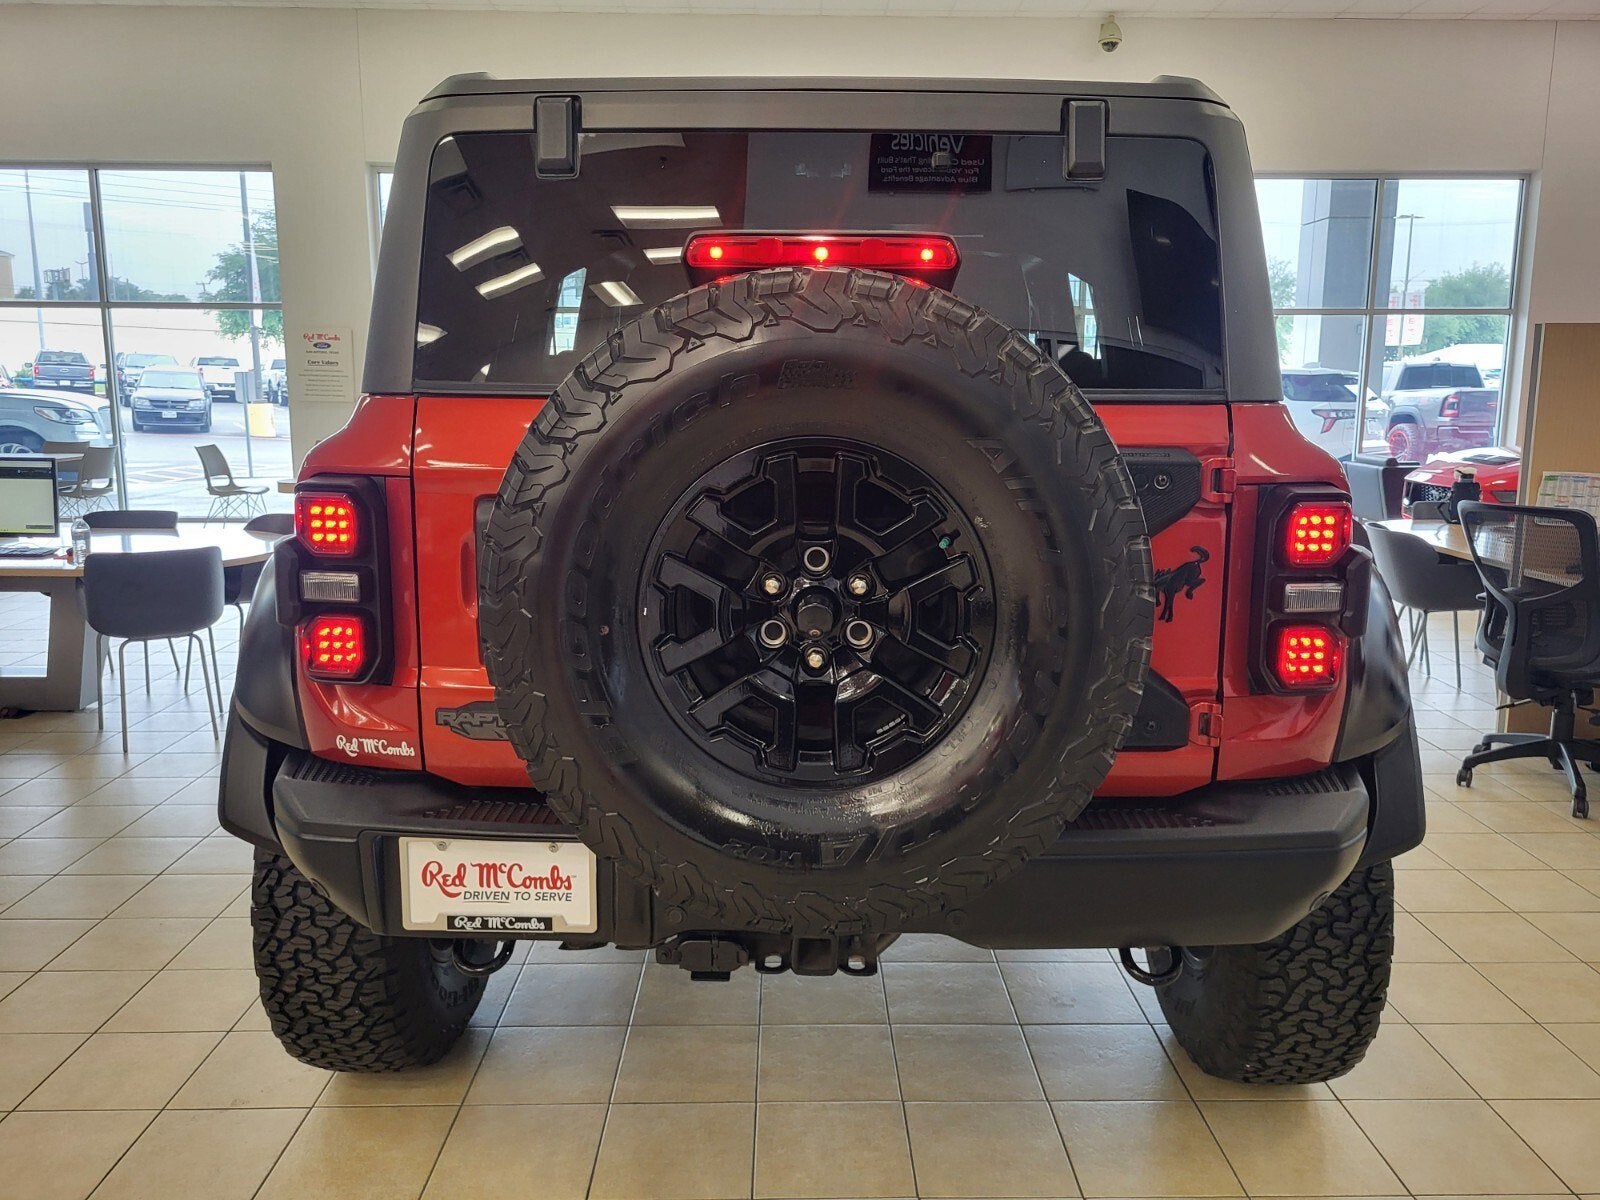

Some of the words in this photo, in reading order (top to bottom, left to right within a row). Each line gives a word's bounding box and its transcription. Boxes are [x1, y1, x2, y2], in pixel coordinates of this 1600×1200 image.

[336, 734, 359, 757] Red
[359, 737, 416, 757] McCombs
[421, 860, 468, 898] Red
[469, 862, 573, 891] McCombs
[463, 890, 510, 901] DRIVEN
[514, 891, 531, 901] TO
[534, 891, 573, 902] SERVE
[454, 915, 482, 930] Red
[483, 915, 546, 931] McCombs
